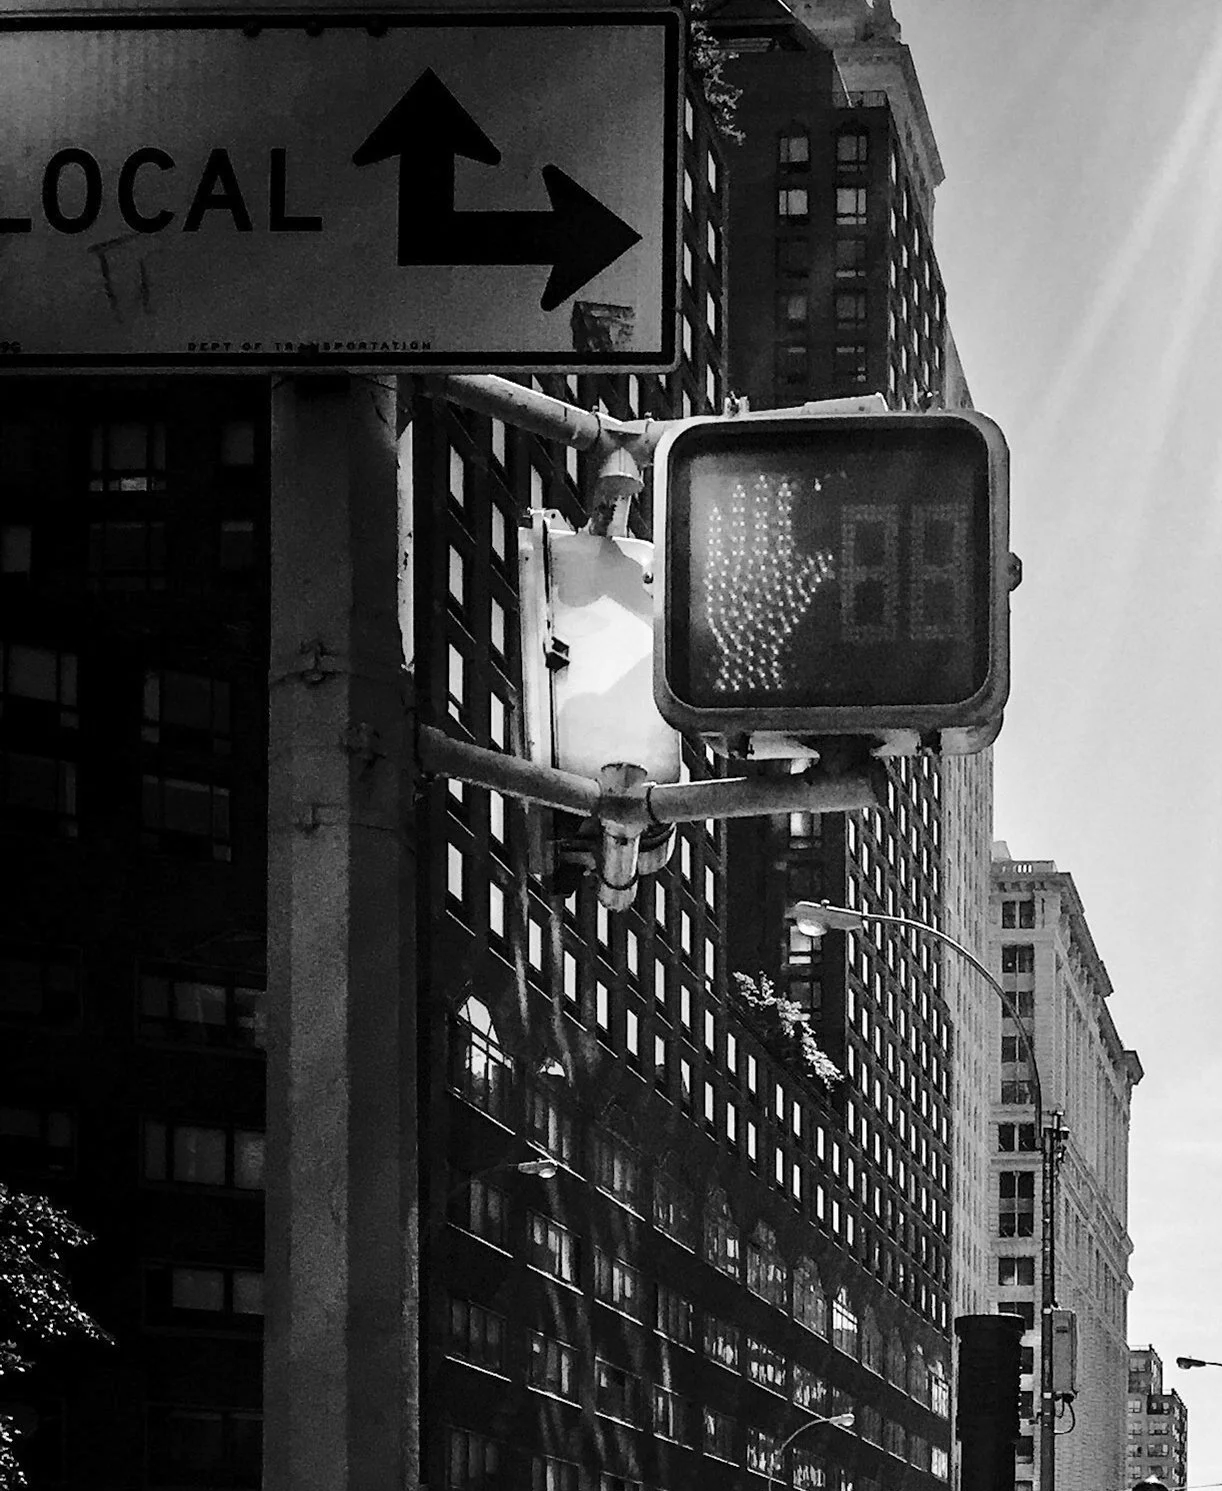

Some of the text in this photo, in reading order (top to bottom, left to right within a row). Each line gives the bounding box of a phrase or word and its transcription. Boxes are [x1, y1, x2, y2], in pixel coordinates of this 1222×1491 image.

[0, 147, 323, 234] OCAL
[187, 342, 232, 351] DEPT
[241, 342, 263, 351] OF
